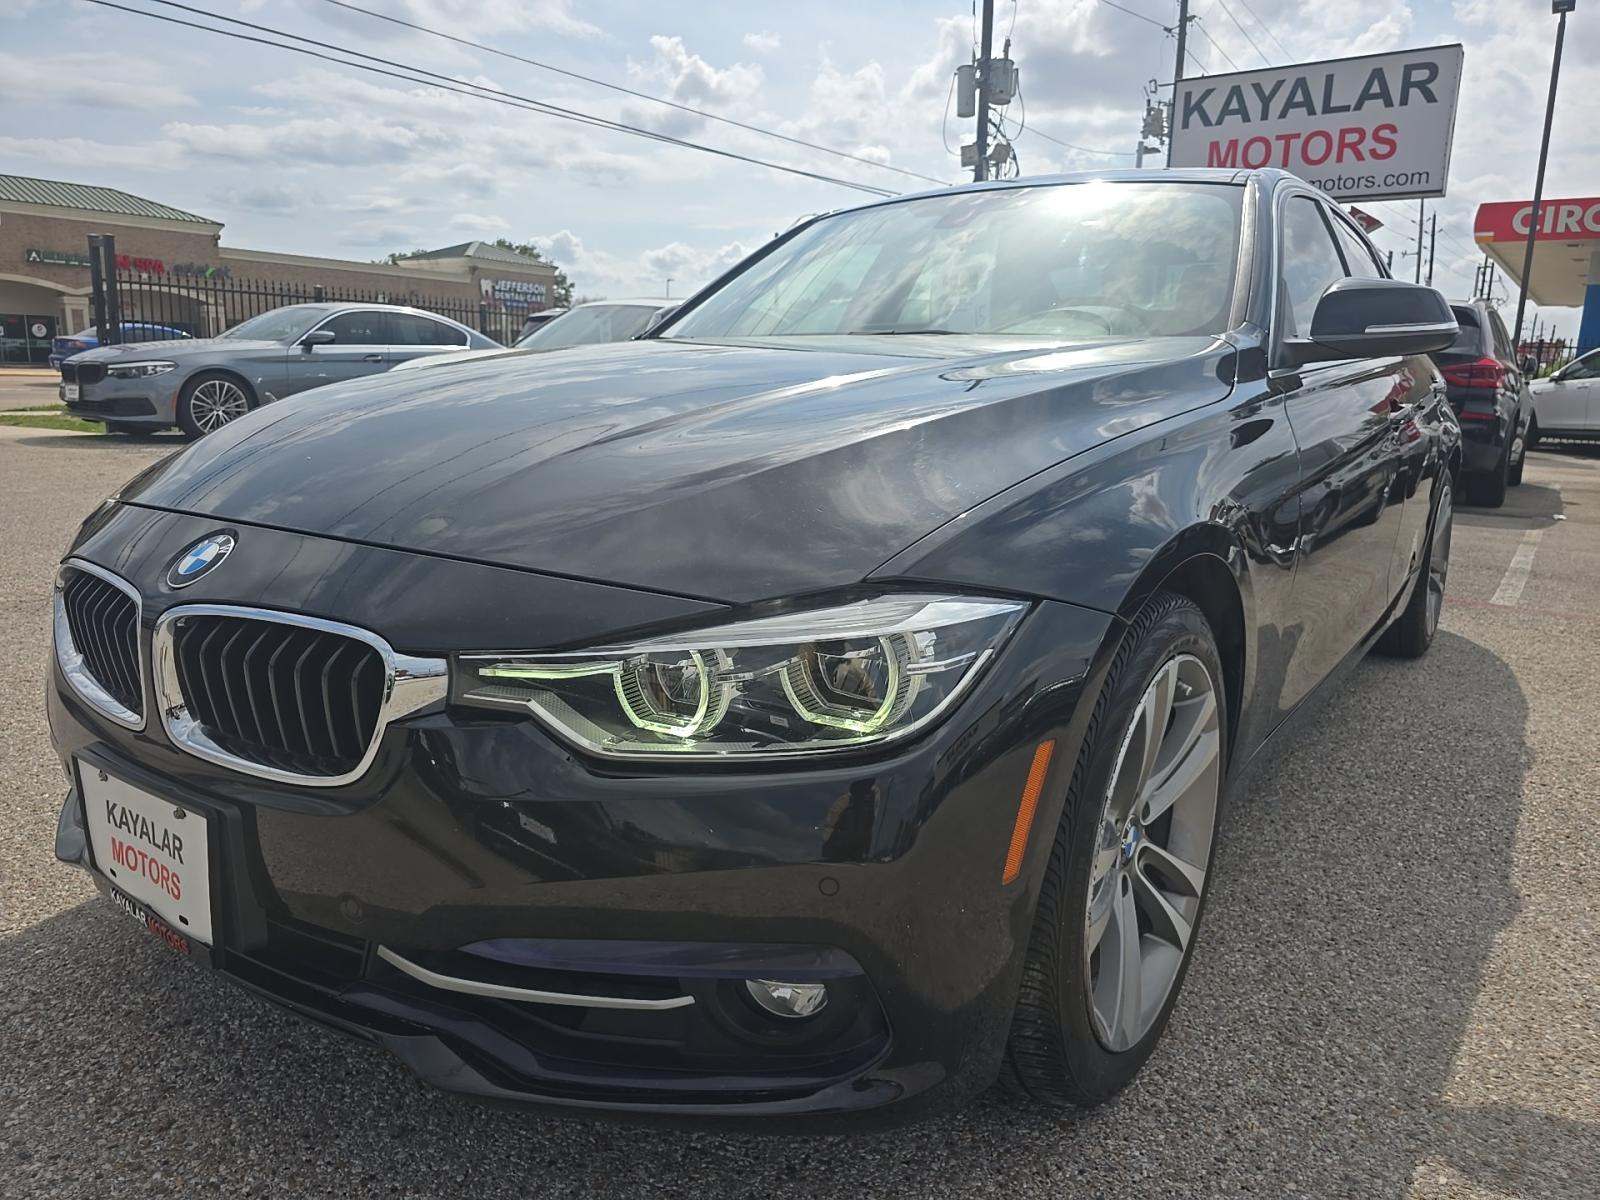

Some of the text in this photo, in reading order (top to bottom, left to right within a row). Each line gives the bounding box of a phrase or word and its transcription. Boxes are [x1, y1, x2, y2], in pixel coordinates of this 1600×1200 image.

[1181, 61, 1439, 130] KAYALAR
[1207, 123, 1398, 169] MOTORS
[495, 280, 546, 295] JEFFERSON
[106, 800, 185, 865] KAYALAR
[111, 836, 181, 901] MOTORS
[110, 887, 191, 954] KAYALAR MOTORS
